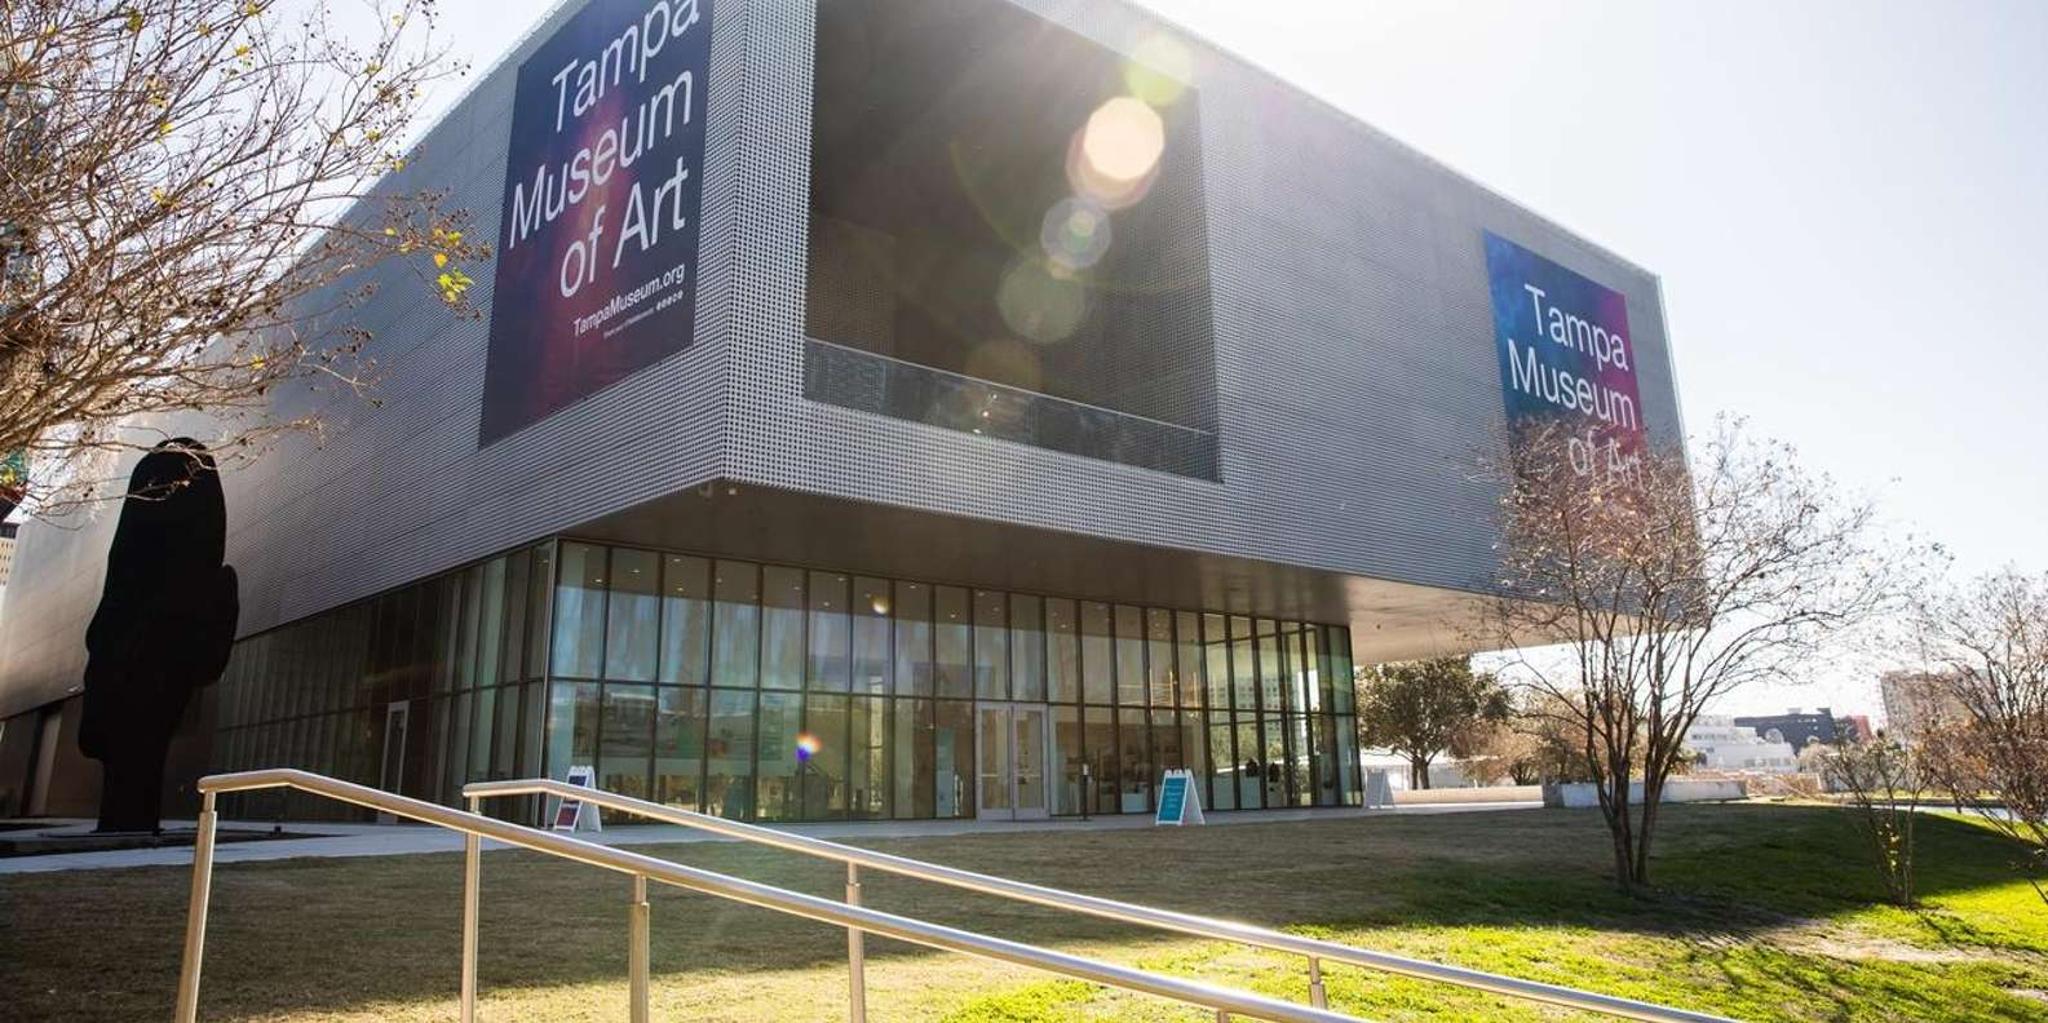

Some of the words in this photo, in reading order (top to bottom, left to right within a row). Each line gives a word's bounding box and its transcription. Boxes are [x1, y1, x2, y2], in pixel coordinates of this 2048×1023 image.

[552, 0, 700, 133] Tampa
[508, 70, 693, 249] Museum
[560, 205, 606, 298] of
[613, 157, 689, 269] Art
[573, 263, 685, 337] TampaMuseum.org
[1524, 283, 1629, 371] Tampa
[1507, 338, 1637, 430] Museum
[1568, 425, 1600, 478] of
[1606, 437, 1645, 493] Art
